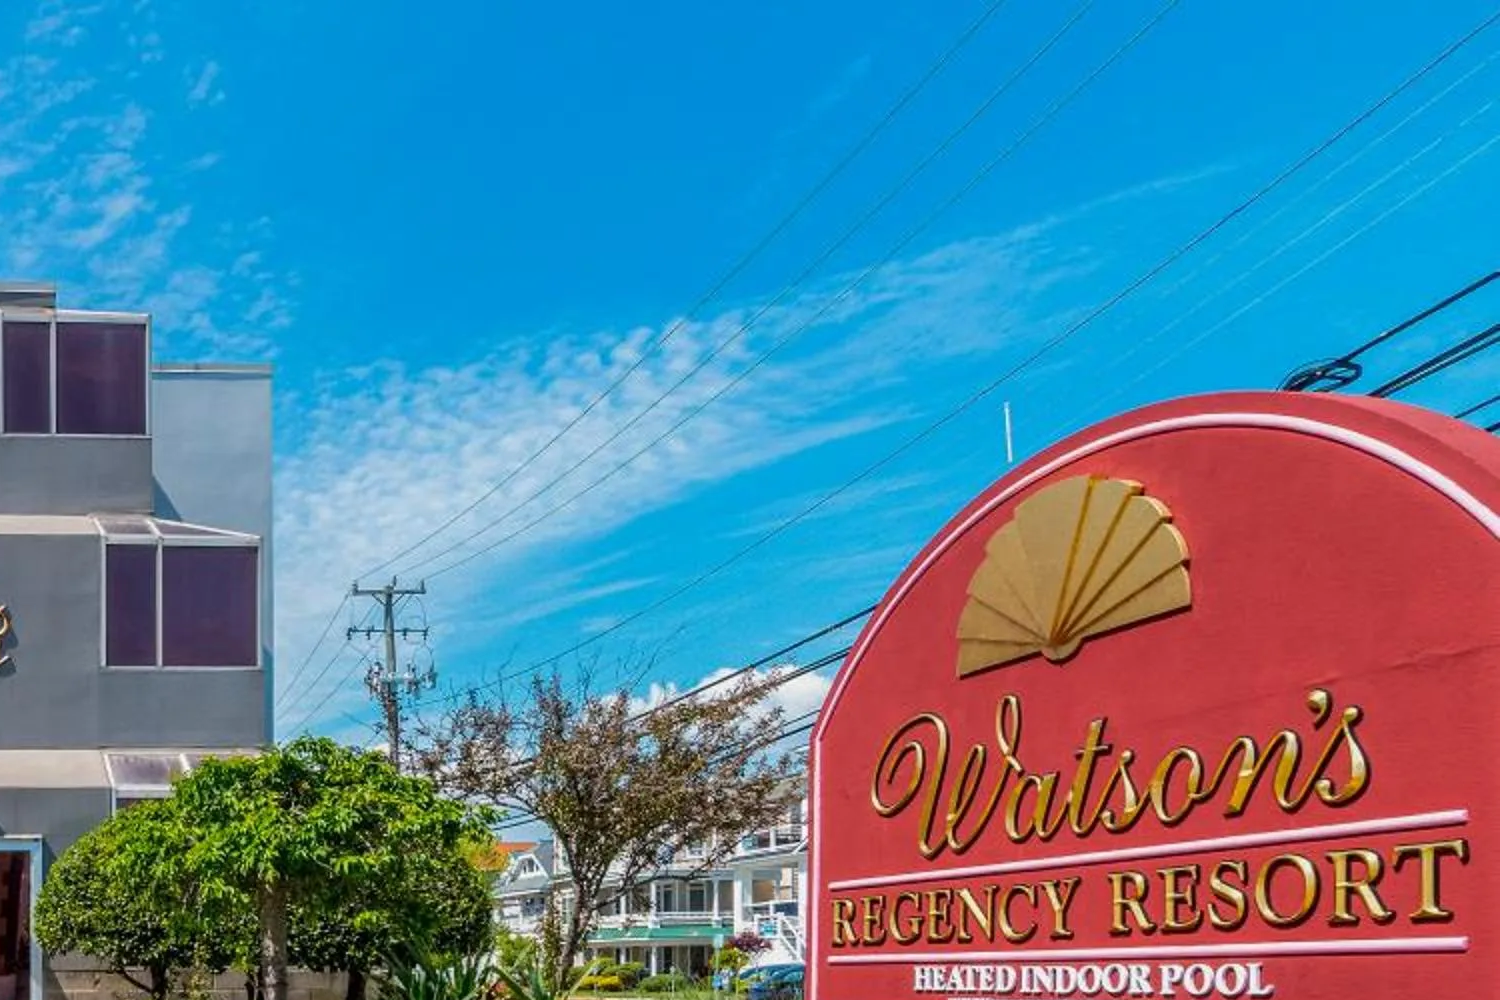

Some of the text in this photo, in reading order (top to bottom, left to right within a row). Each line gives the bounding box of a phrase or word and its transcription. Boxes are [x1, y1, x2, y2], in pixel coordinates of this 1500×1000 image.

[870, 687, 1372, 859] Watson's
[830, 838, 1469, 947] REGENCY RESORT
[913, 961, 1276, 1000] HEATED INDOOR POOL
